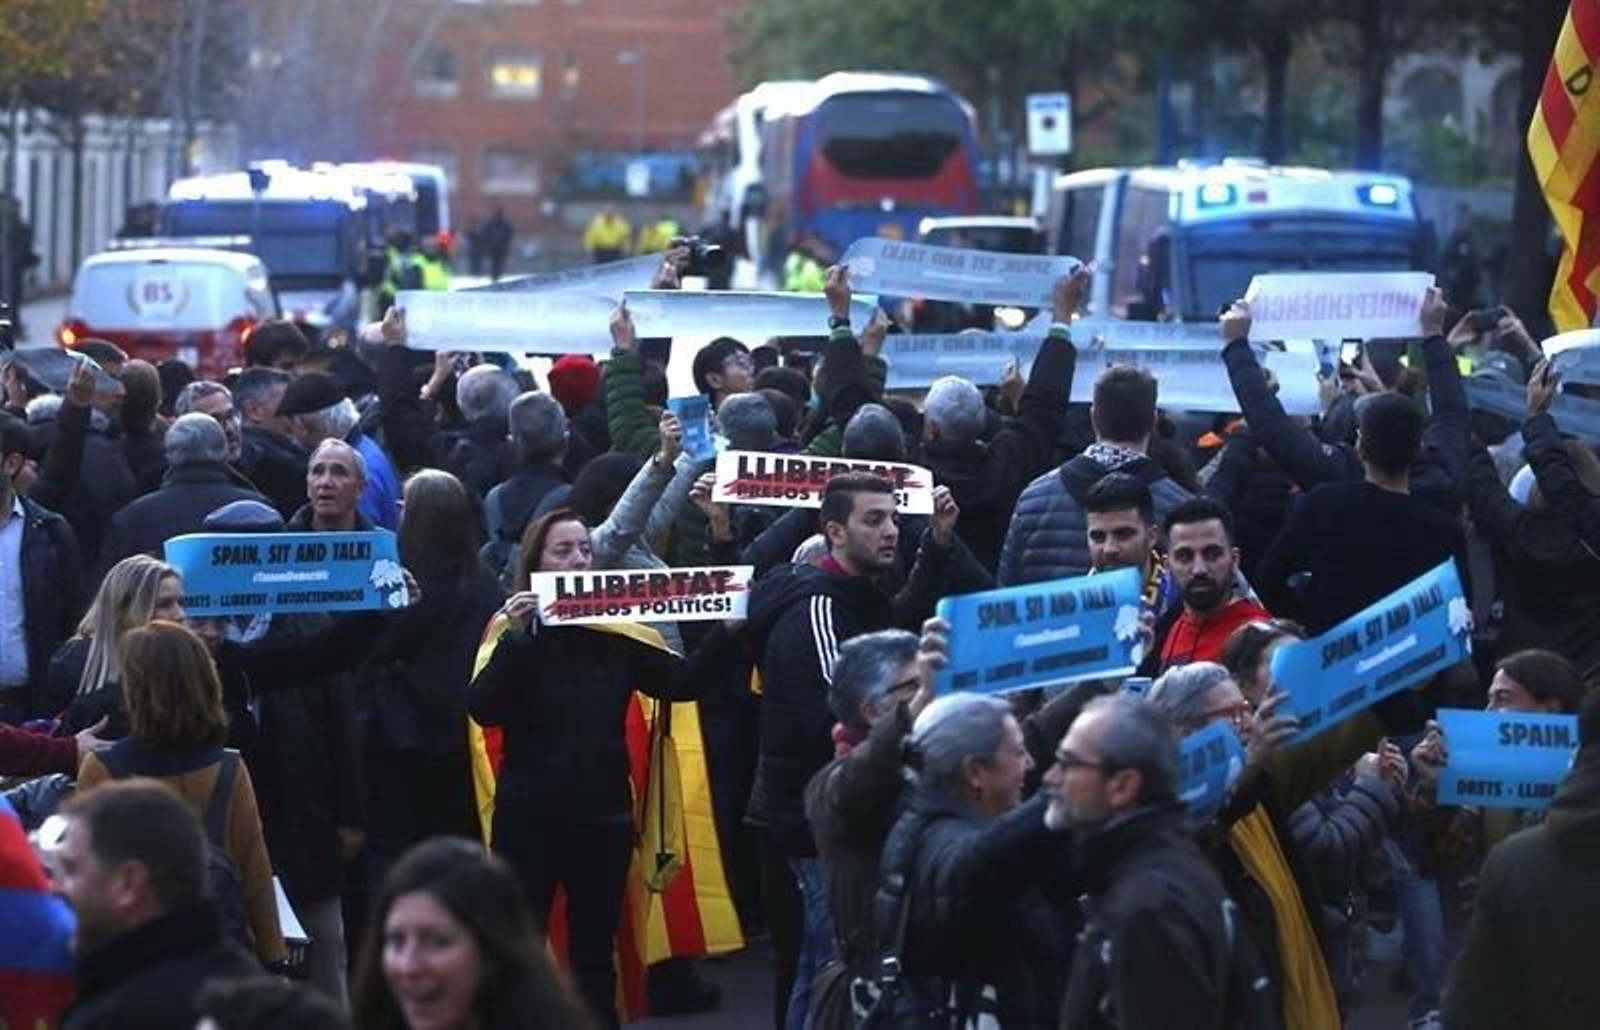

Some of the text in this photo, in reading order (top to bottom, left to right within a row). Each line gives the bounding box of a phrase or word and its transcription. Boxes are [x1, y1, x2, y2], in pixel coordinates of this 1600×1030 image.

[212, 541, 371, 566] SPAIN, SIT AND TALK!
[555, 570, 735, 600] LLIBERTAT
[640, 597, 733, 615] POLITICS!
[1499, 721, 1576, 747] SPAIN,
[1457, 779, 1503, 797] DRETS
[1518, 783, 1557, 798] LLIBE
